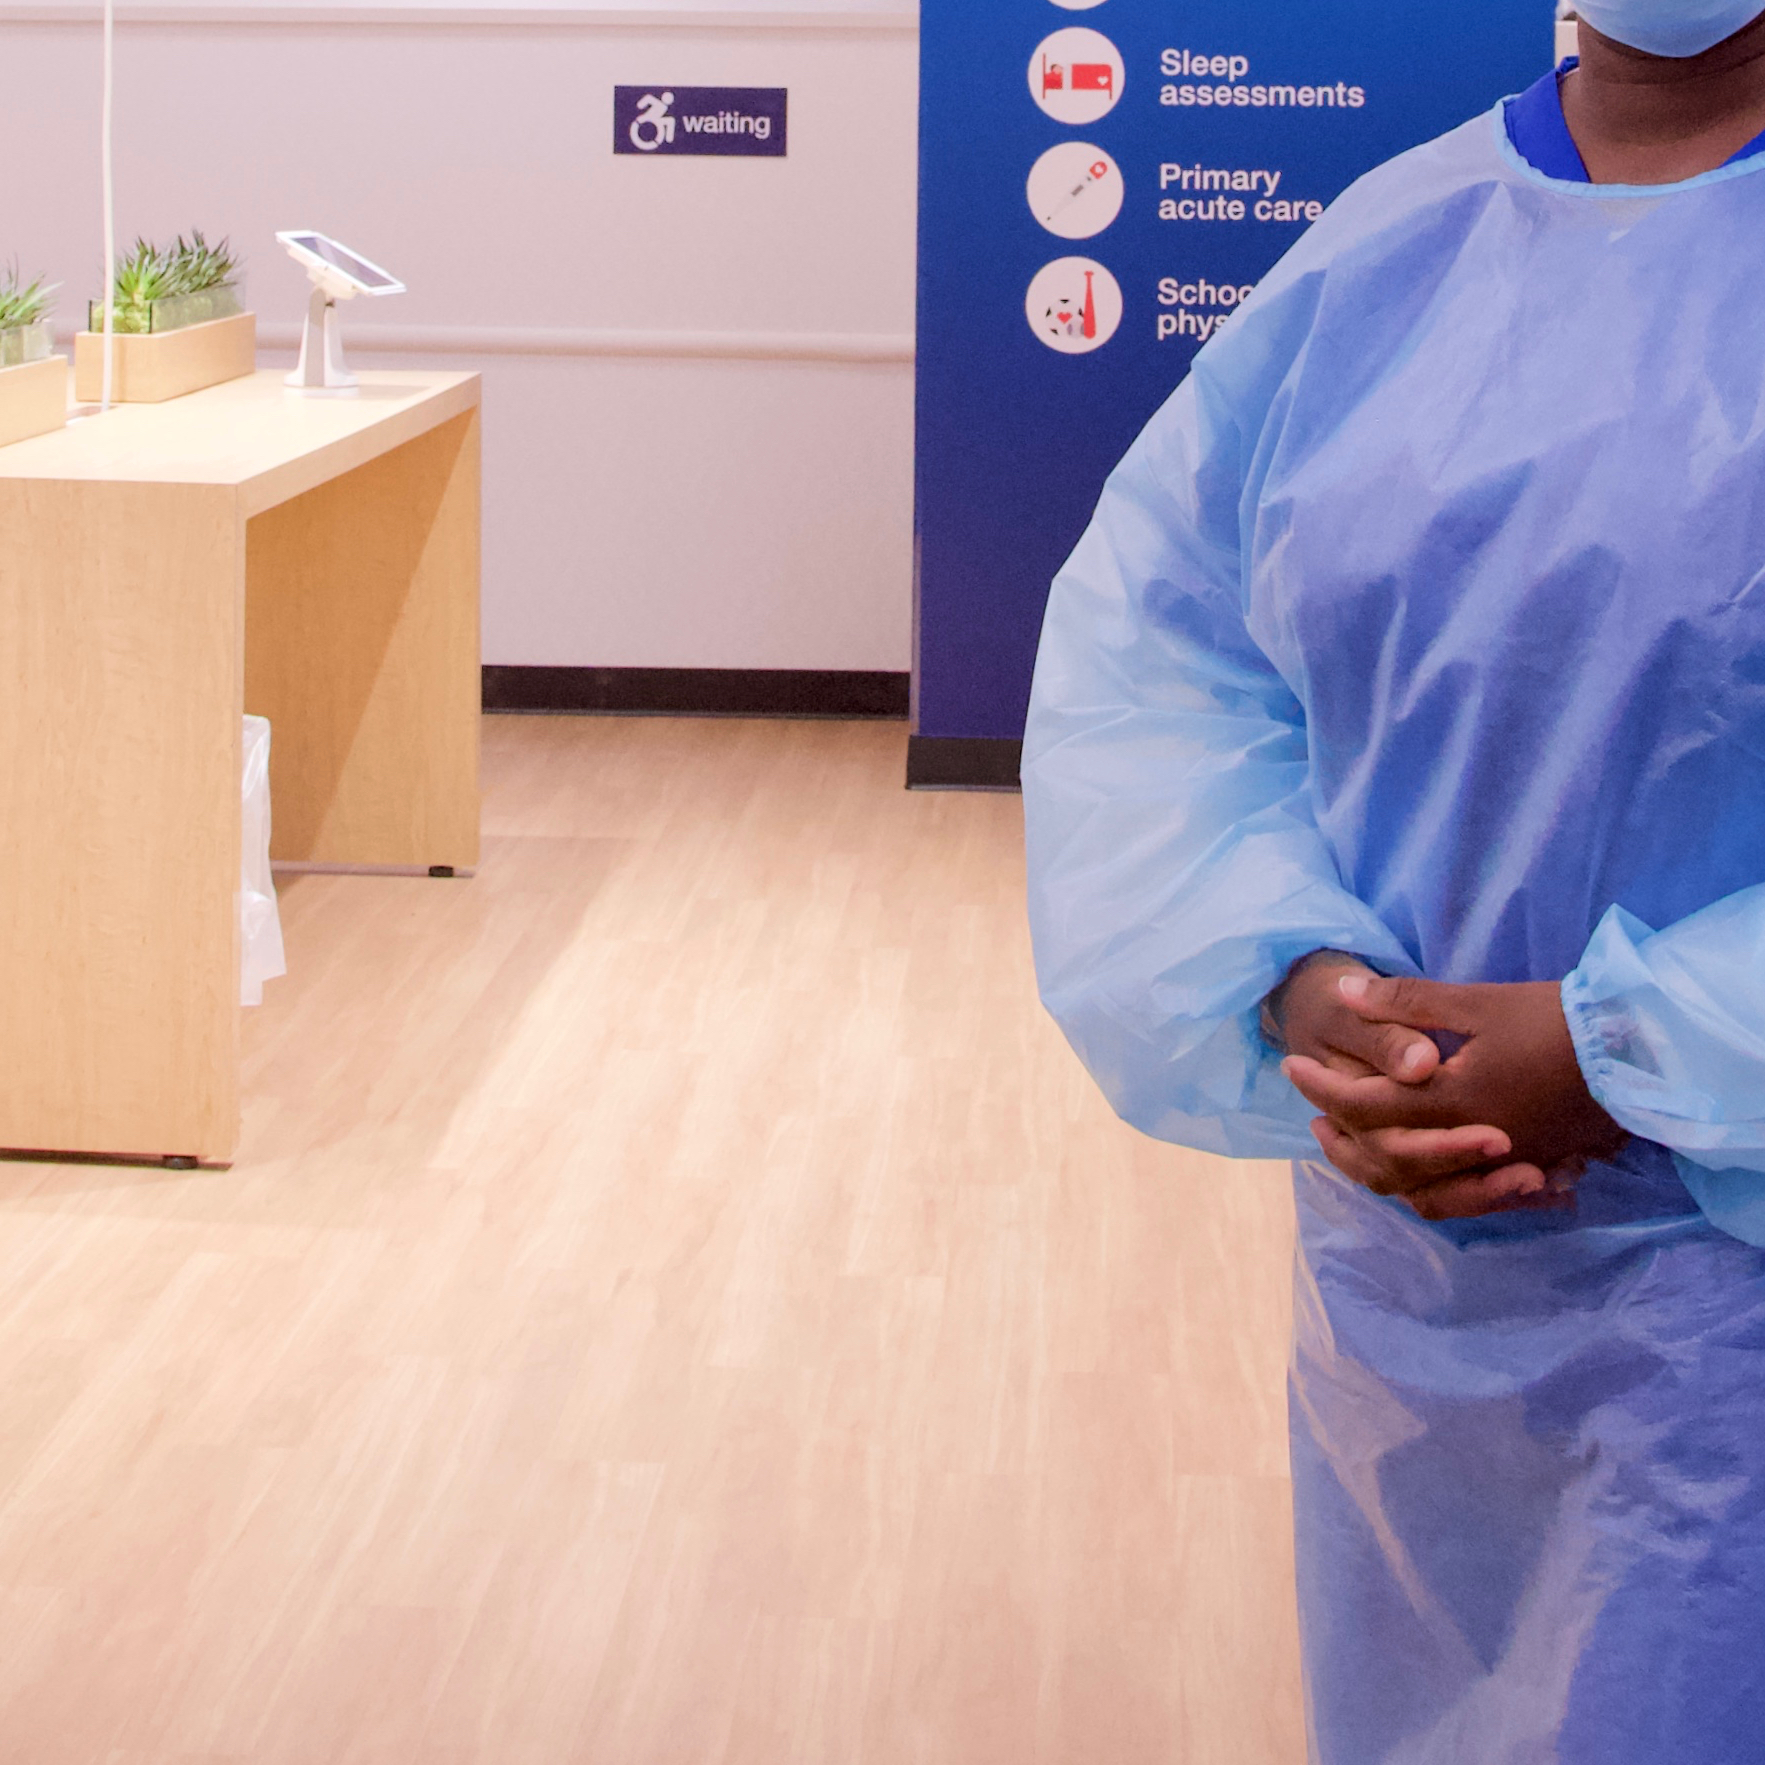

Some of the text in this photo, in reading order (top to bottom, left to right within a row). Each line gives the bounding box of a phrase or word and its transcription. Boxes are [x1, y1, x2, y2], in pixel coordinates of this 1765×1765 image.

[1159, 49, 1249, 80] Sleep
[1159, 81, 1365, 108] assessments
[682, 111, 770, 140] waiting
[1159, 165, 1281, 197] Primary
[1158, 197, 1324, 222] acute care
[1157, 277, 1255, 306] Schoo
